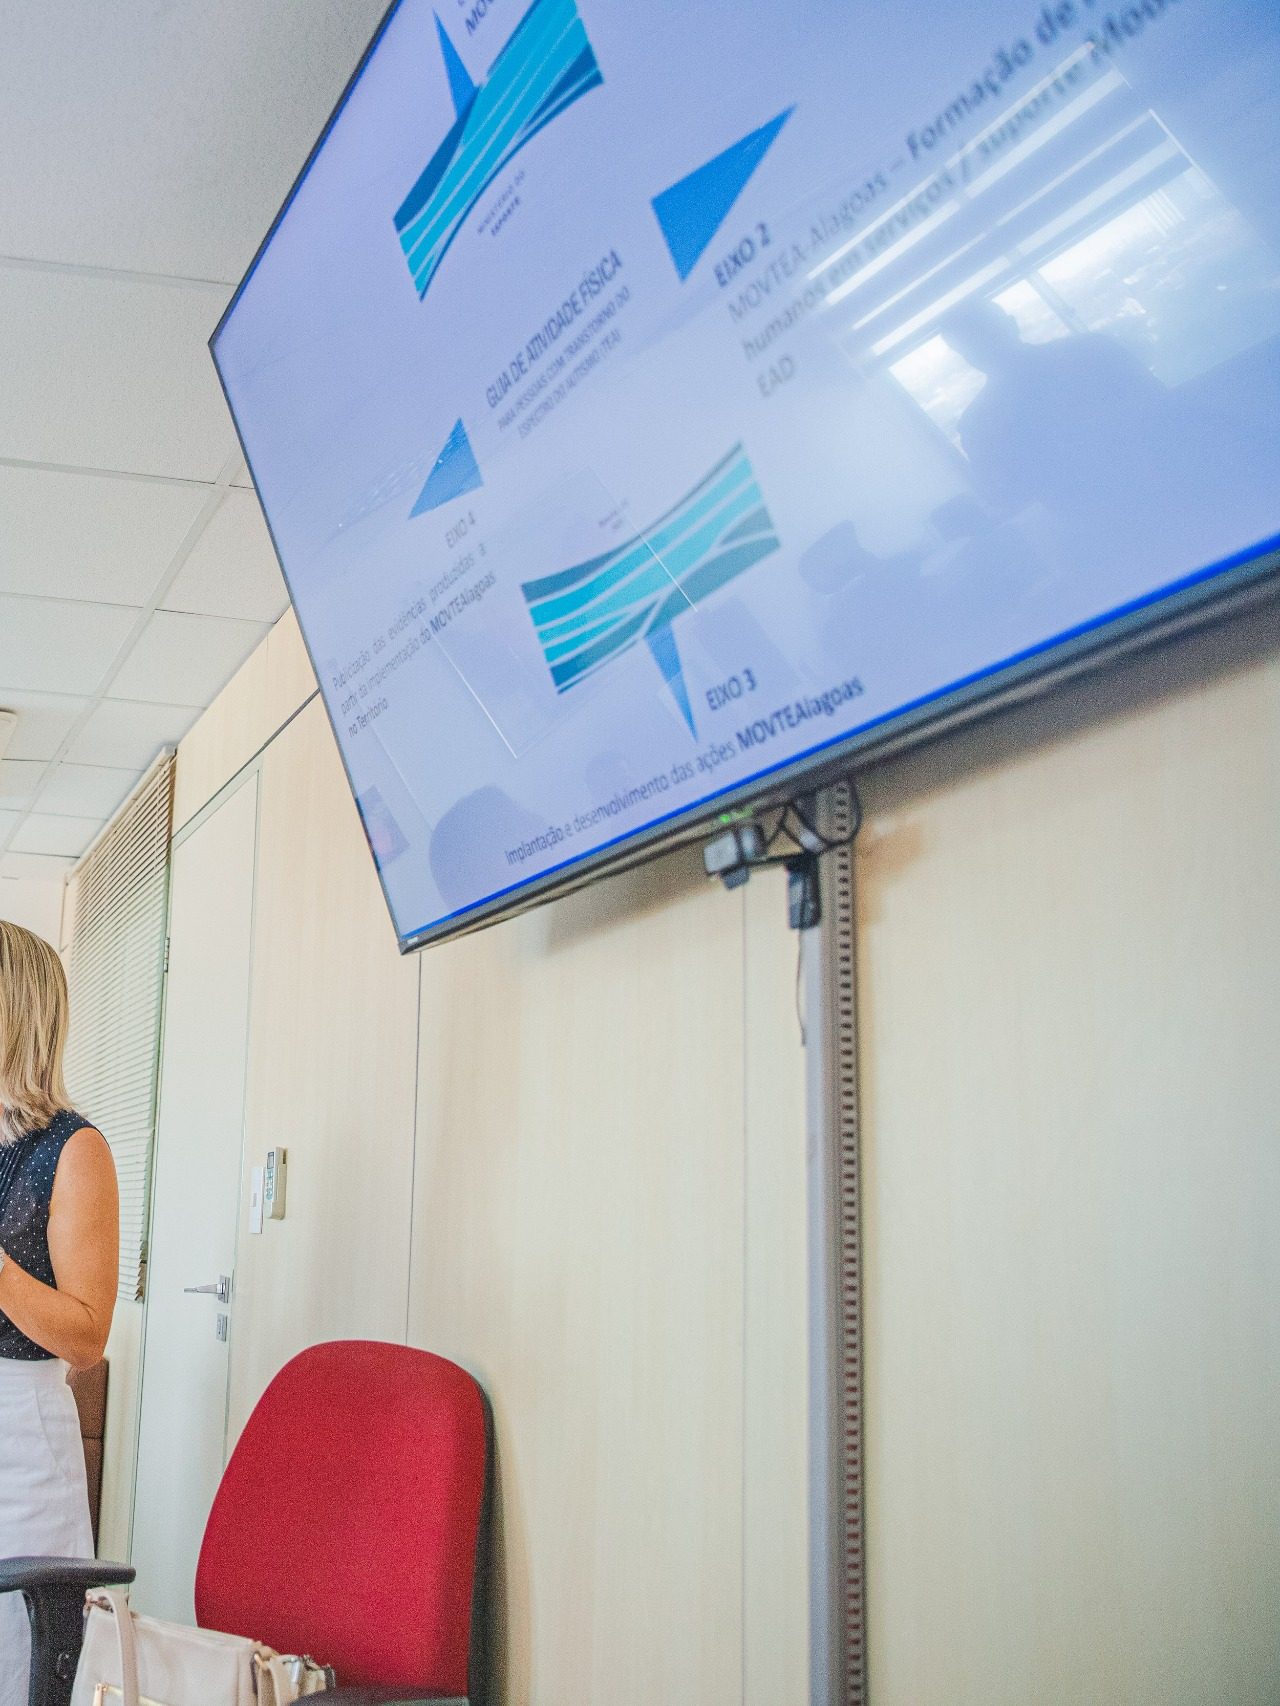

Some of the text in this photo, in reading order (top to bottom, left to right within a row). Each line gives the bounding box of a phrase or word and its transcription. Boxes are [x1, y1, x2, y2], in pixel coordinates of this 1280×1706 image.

[810, 171, 888, 247] Alagoas
[906, 36, 1034, 160] Formação
[1036, 0, 1078, 46] de
[713, 220, 771, 288] EIXO 2
[742, 278, 826, 362] humanos
[828, 250, 863, 288] em
[864, 171, 954, 252] serviços
[486, 250, 623, 408] GUIA DE ATIVIDADE FÍSICA
[756, 353, 796, 399] EAD
[444, 510, 476, 550] EIXO 4
[387, 597, 428, 643] evidências
[705, 668, 759, 712] EIXO 3
[348, 720, 358, 738] no
[504, 677, 865, 868] Implantação e desenvolvimento das ações MOVTEAlagoas
